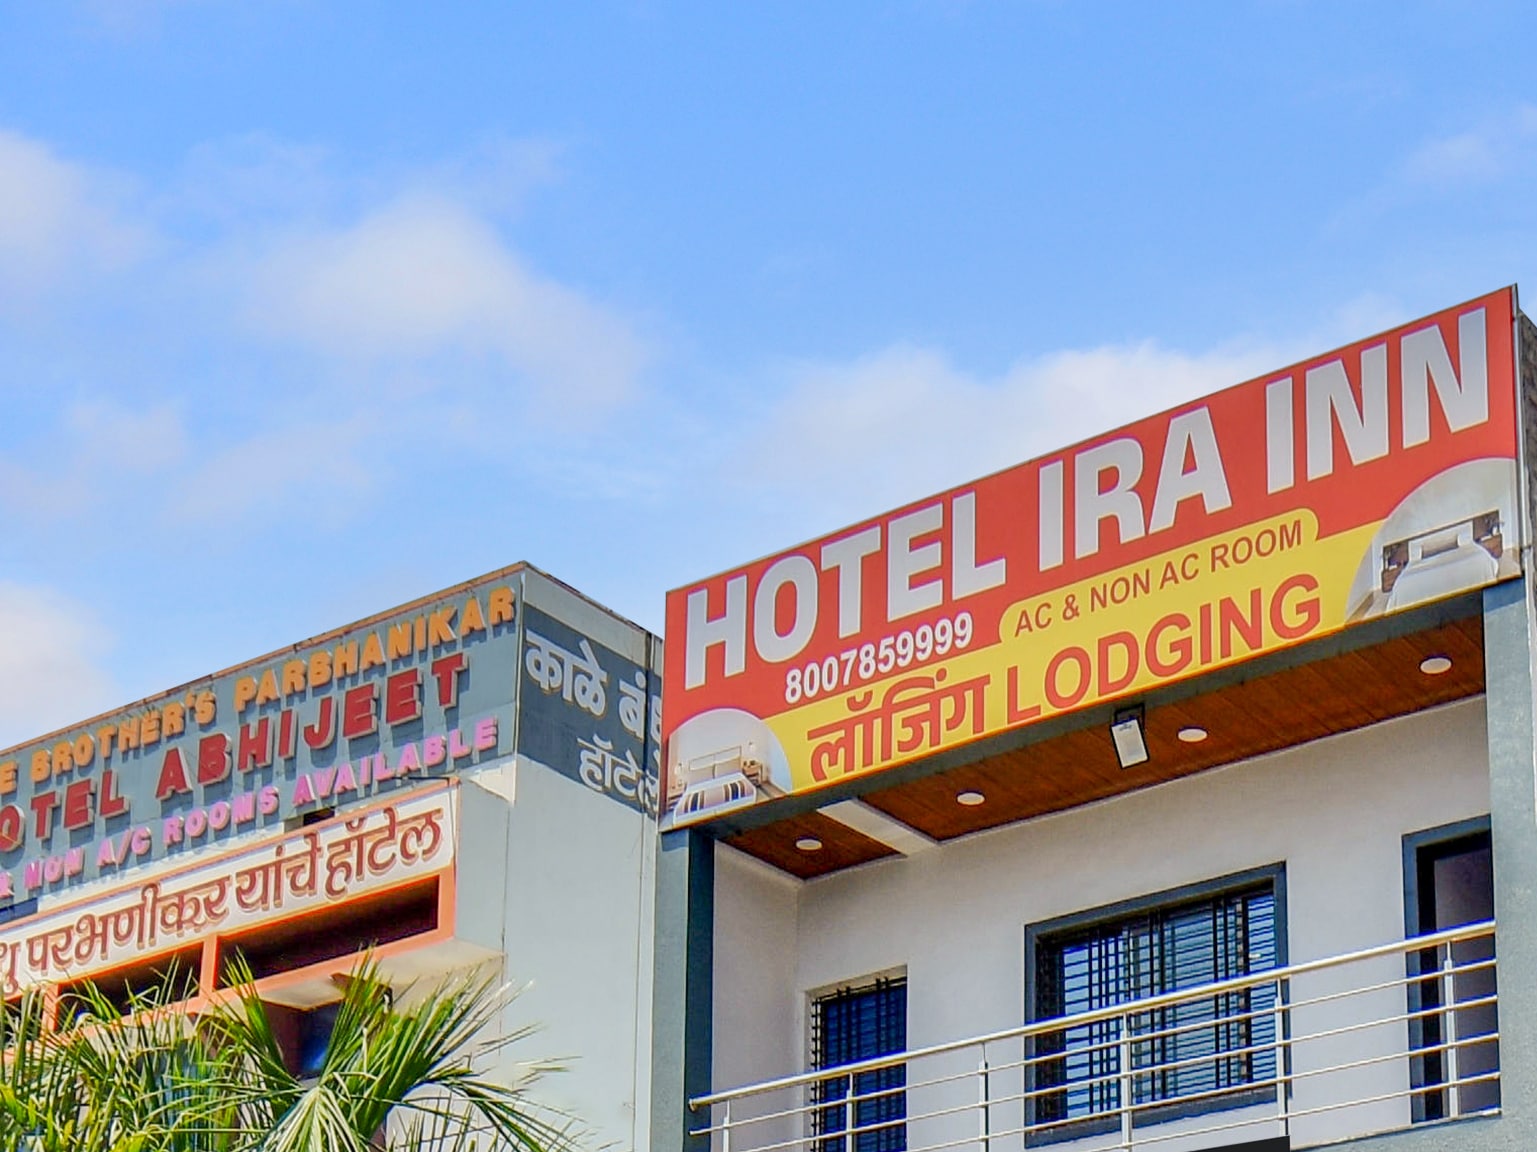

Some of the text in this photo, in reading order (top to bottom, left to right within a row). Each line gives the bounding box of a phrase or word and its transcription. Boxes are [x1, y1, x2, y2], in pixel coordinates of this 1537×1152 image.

[684, 305, 1490, 690] HOTEL IRA INN
[1007, 573, 1321, 725] LODGING
[1014, 519, 1302, 638] AC & NON AC ROOM
[31, 690, 217, 784] BROTHER'S
[234, 585, 516, 713] PARBHANIKAR
[155, 652, 468, 801] ABHIJEET
[525, 628, 608, 718] काळे
[785, 611, 973, 704] 8007859999
[807, 667, 991, 783] लॉजिंग
[24, 846, 85, 891] NON
[96, 826, 152, 869] A/C
[163, 786, 280, 846] ROOMS
[292, 715, 498, 807] AVAILABLE
[26, 875, 232, 976] परभणीकर
[325, 807, 444, 899] हॉटेल
